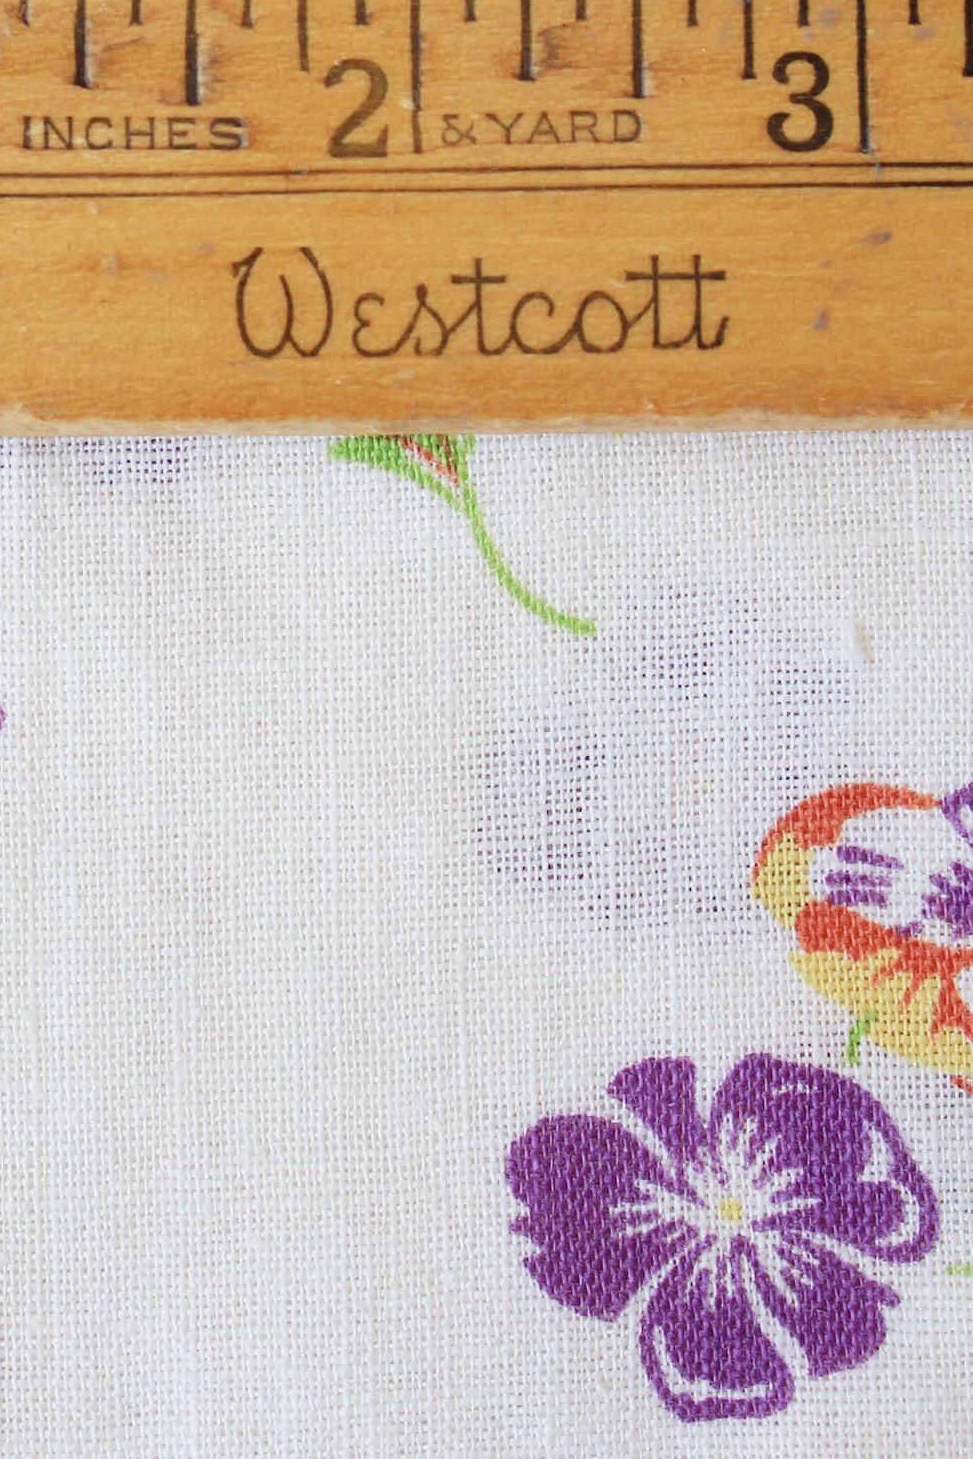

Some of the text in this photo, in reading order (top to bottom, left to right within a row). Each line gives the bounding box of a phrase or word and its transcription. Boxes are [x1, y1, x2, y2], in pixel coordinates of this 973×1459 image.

[22, 115, 245, 150] INCHES
[324, 58, 389, 158] 2
[766, 51, 834, 153] 3
[231, 247, 729, 358] Westcott
